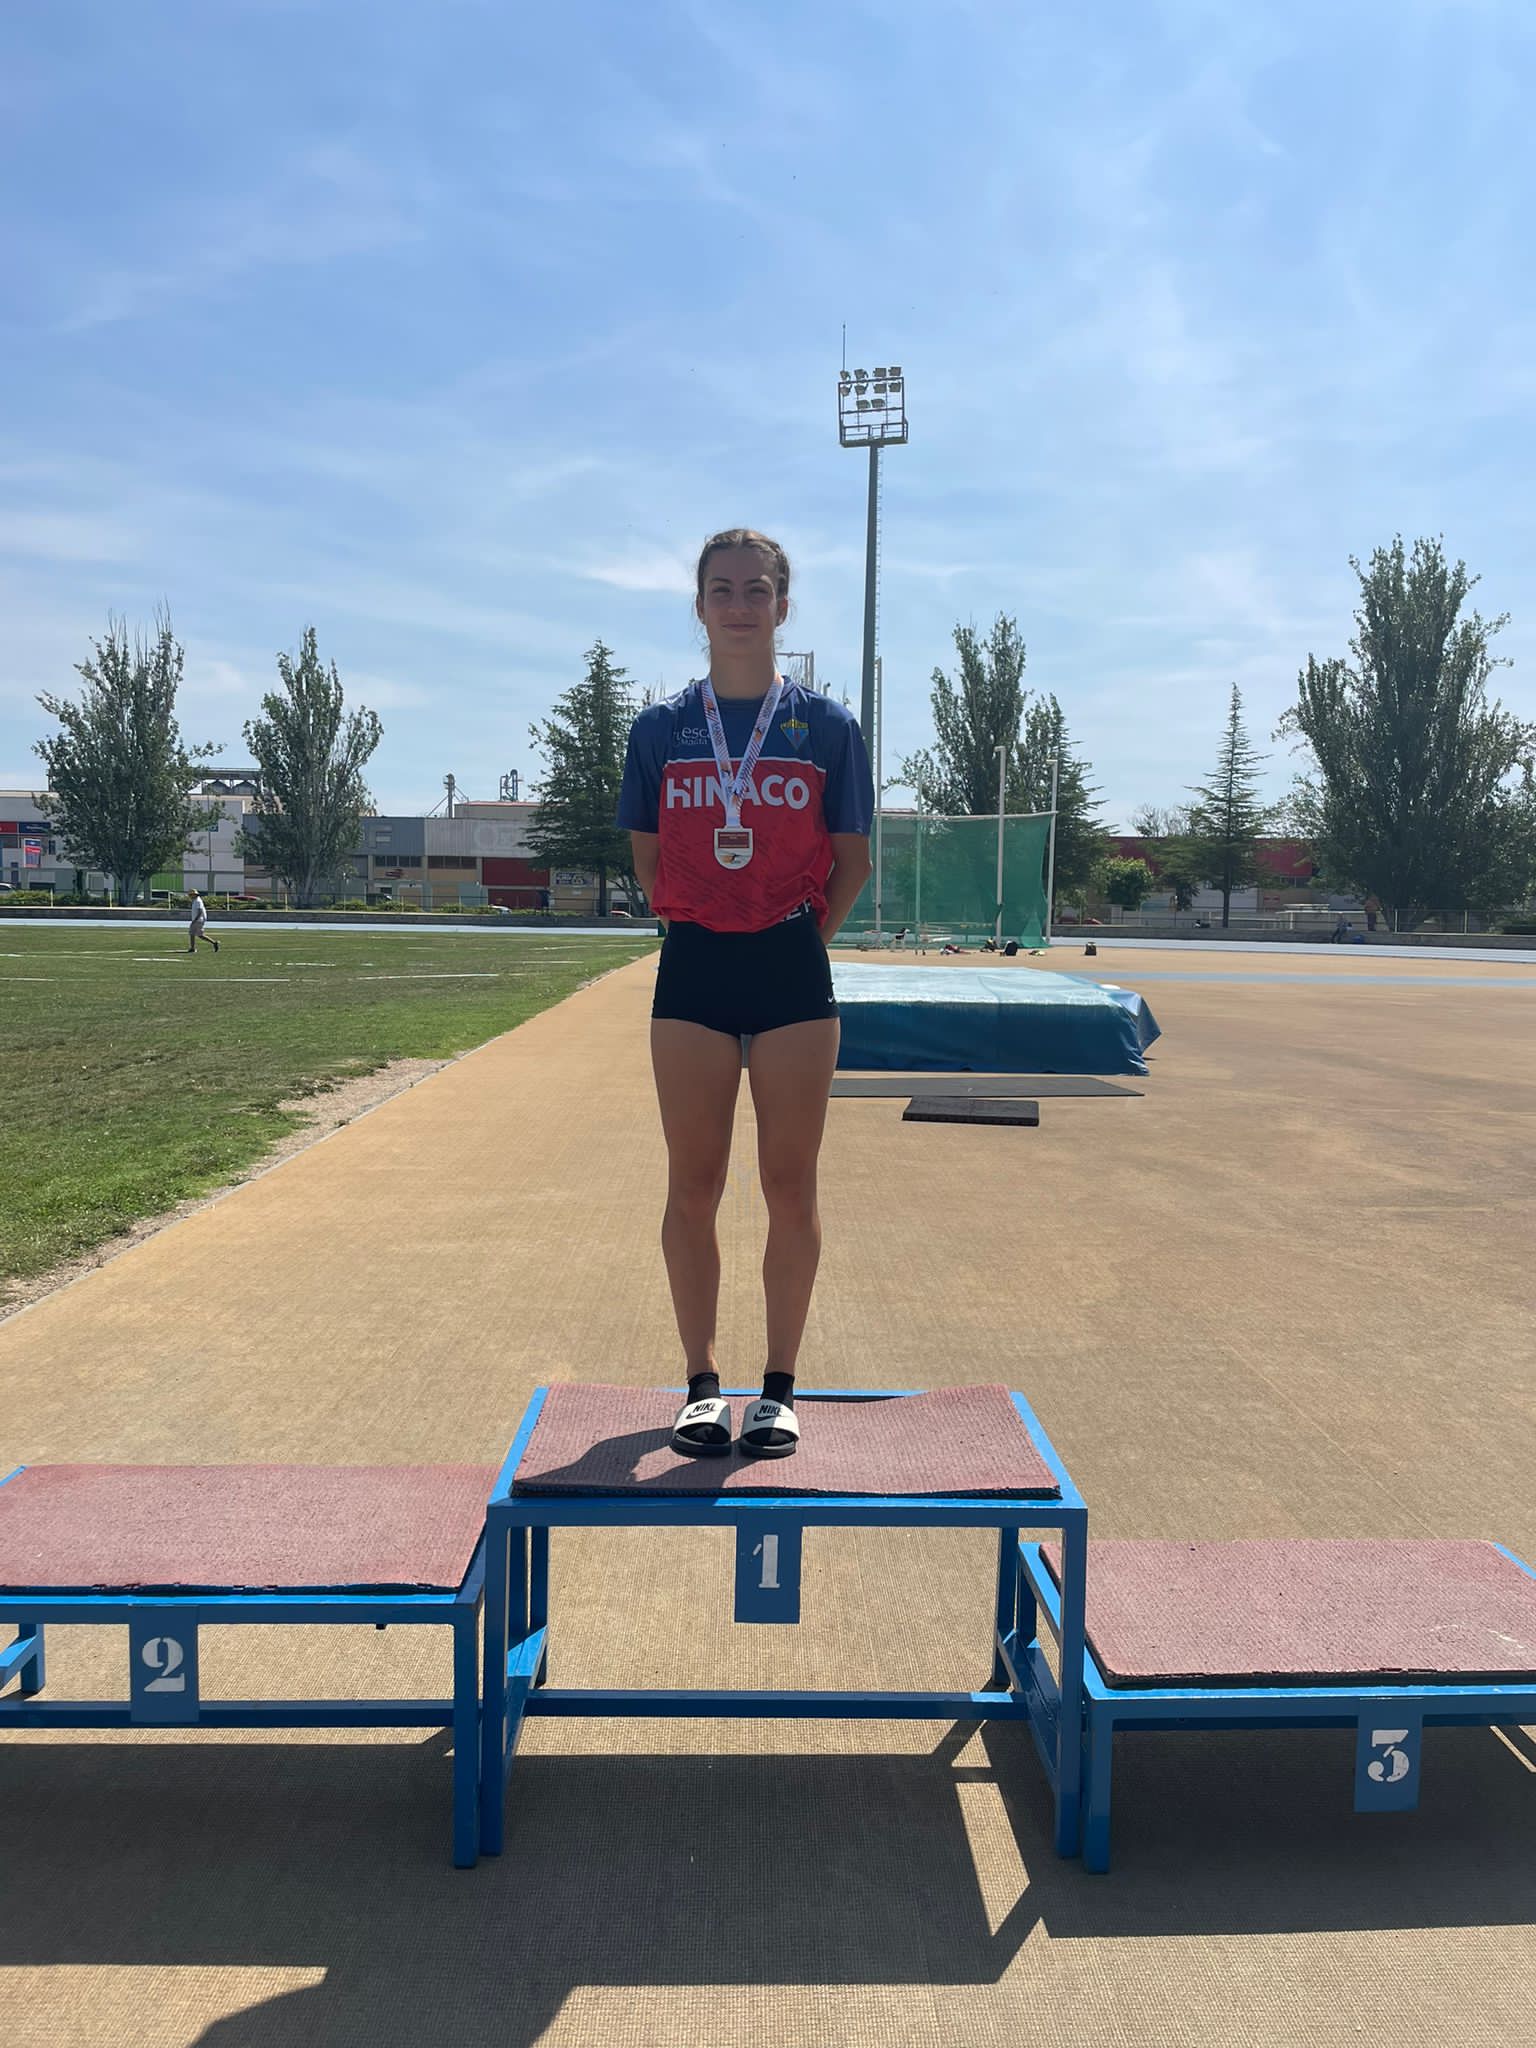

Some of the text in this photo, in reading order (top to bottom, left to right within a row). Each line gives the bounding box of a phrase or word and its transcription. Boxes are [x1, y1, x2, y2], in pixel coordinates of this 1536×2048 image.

[692, 1402, 717, 1413] NIKE
[758, 1404, 783, 1415] NIKE
[753, 1534, 780, 1589] 1
[142, 1637, 185, 1692] 2
[1367, 1729, 1410, 1783] 3
